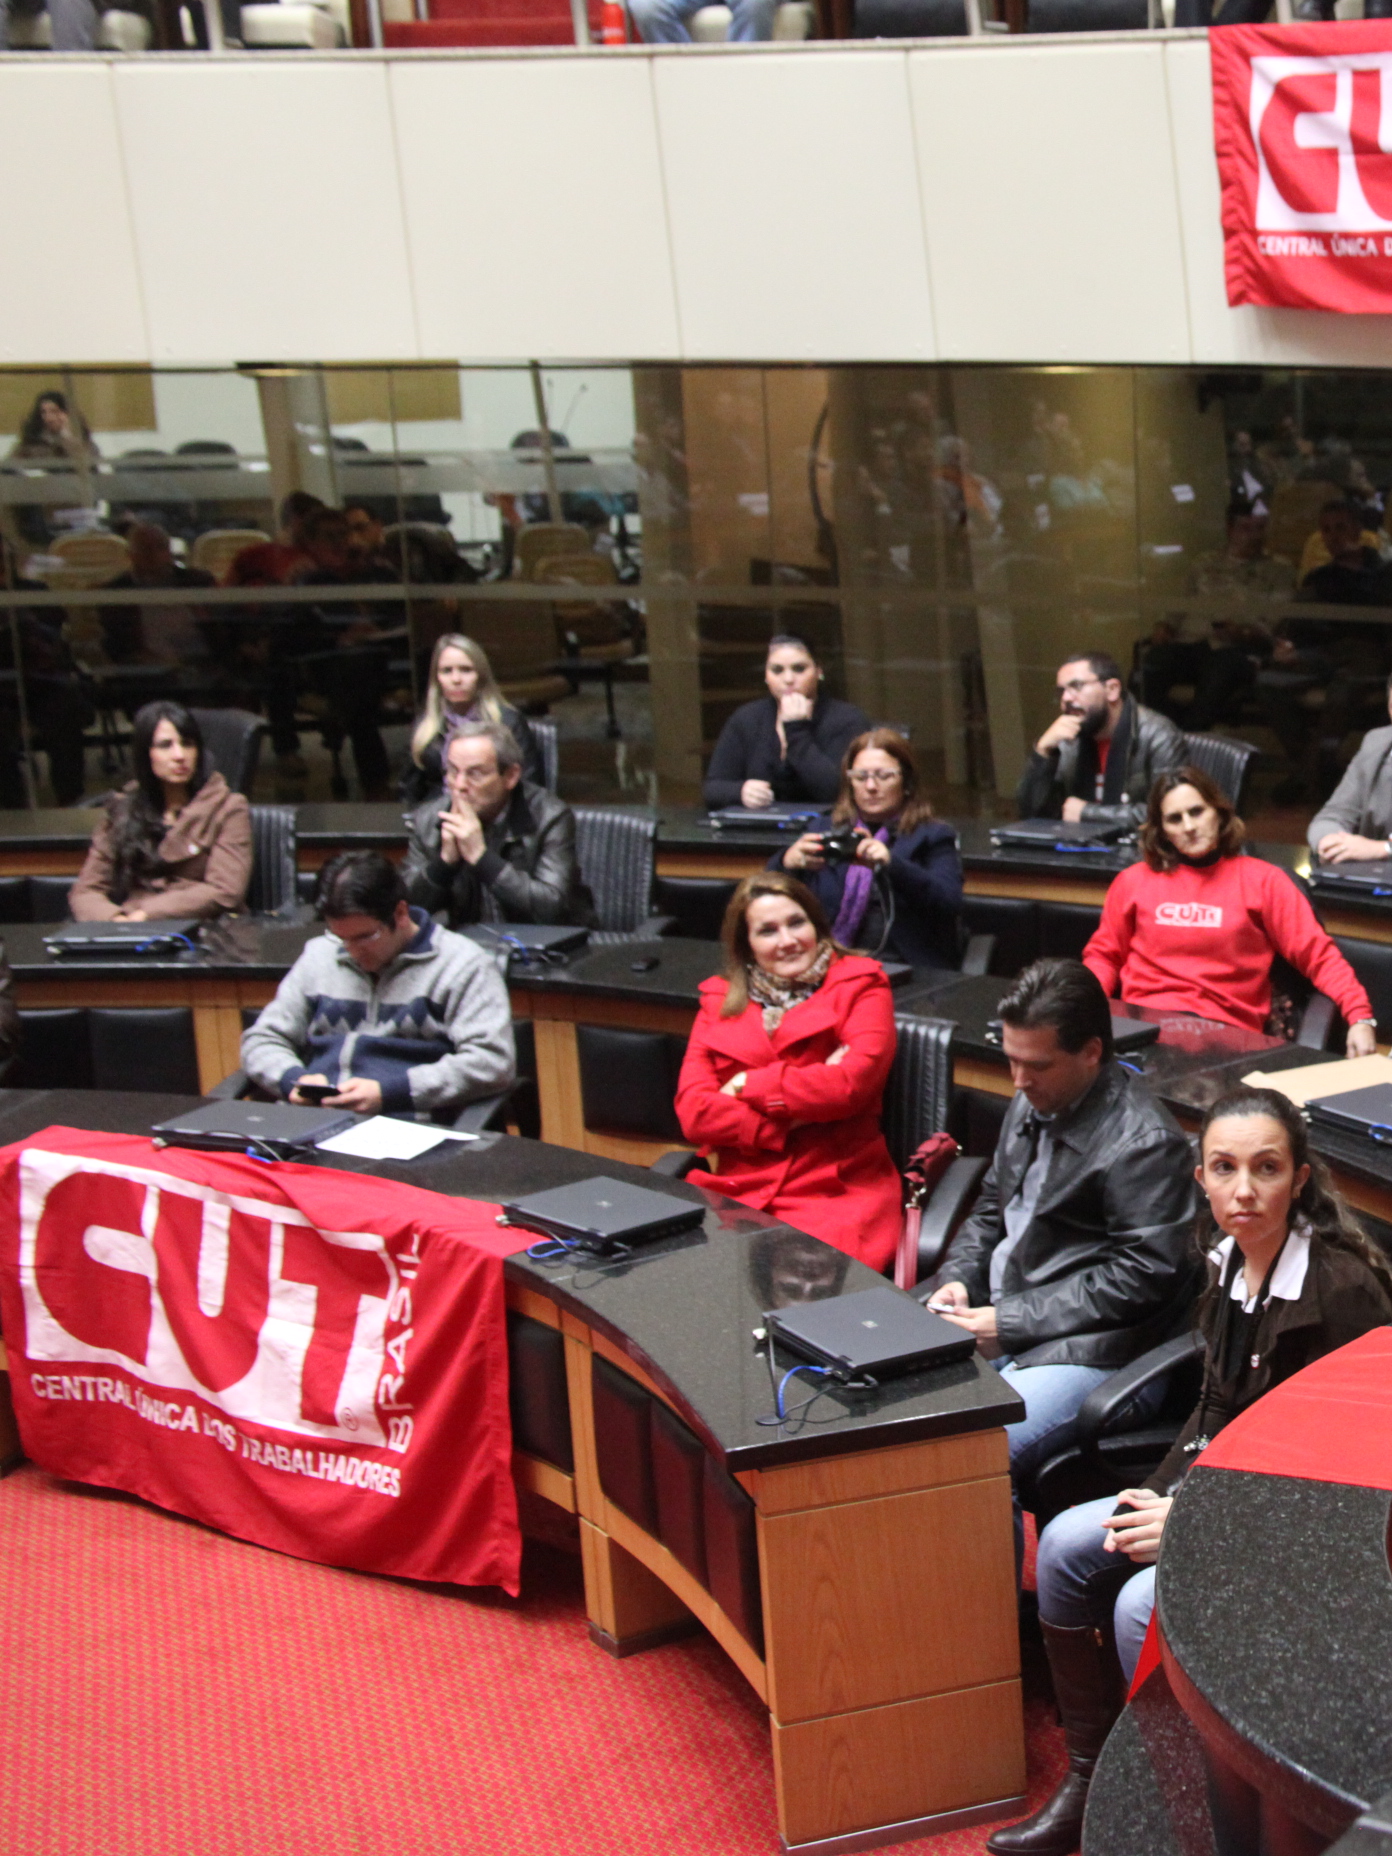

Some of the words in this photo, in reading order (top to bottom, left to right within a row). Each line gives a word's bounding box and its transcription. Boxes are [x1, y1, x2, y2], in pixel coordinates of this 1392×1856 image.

[1257, 235, 1327, 257] CENTRAL
[1331, 233, 1378, 257] ÚNICA
[34, 1171, 392, 1429] CUT
[378, 1233, 422, 1454] BRASIL
[31, 1373, 136, 1411] CENTRAL
[238, 1433, 401, 1498] TRABALHADORES
